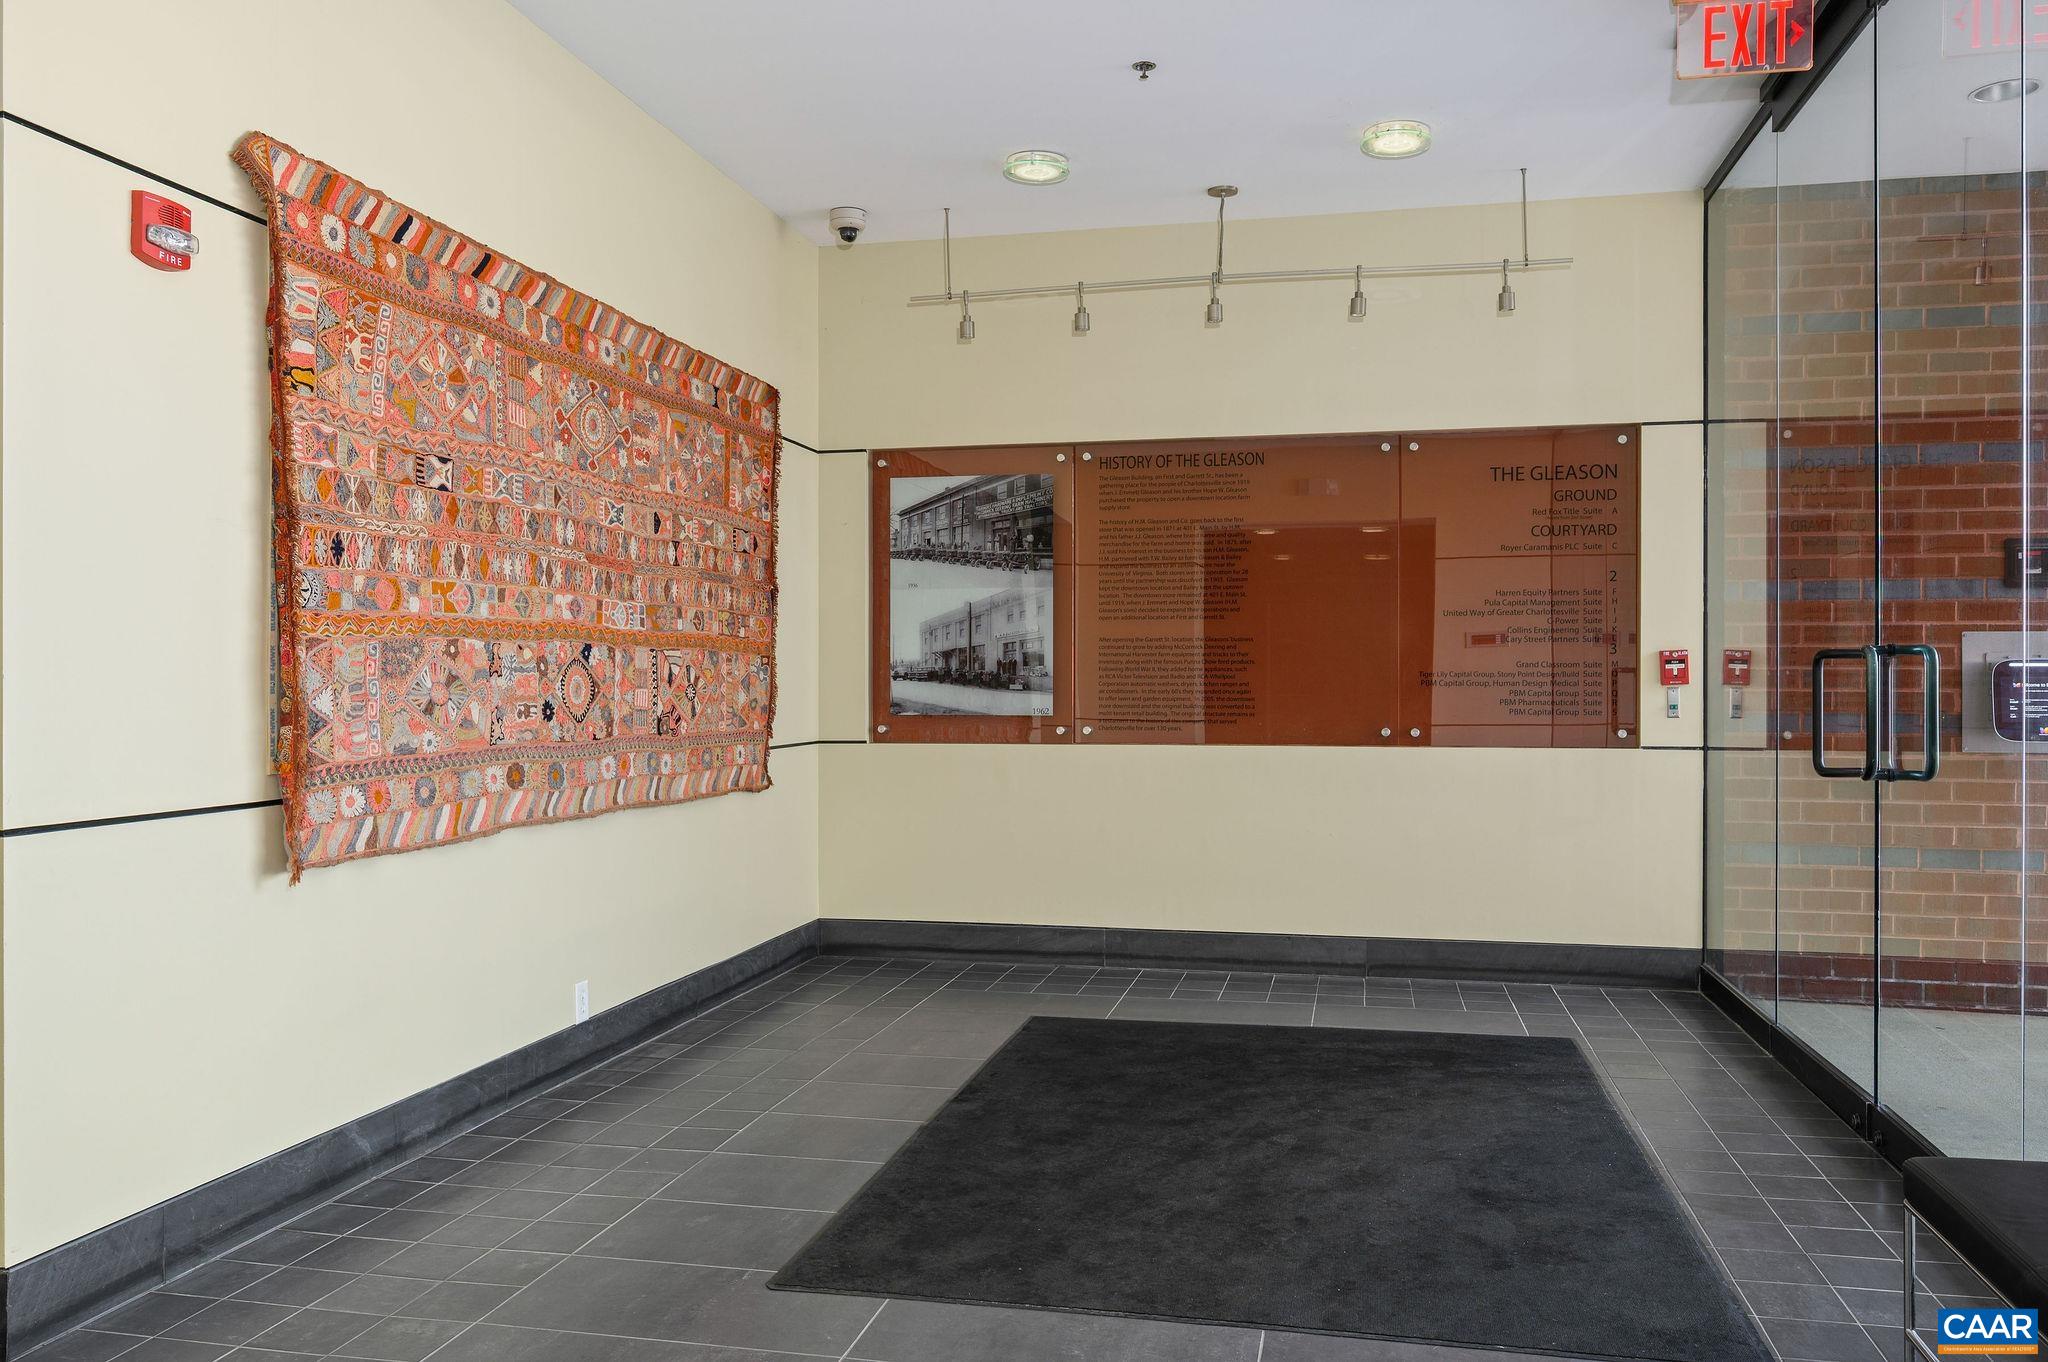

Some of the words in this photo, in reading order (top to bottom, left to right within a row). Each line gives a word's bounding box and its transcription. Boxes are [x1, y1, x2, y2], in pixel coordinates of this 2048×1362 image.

[1704, 1, 1793, 68] EXIT
[159, 251, 182, 266] FIRE
[1100, 456, 1151, 469] HISTORY
[1156, 454, 1173, 468] OF
[1176, 453, 1200, 467] THE
[1204, 452, 1264, 466] GLEASON
[1490, 466, 1525, 482] THE
[1531, 464, 1617, 481] GLEASON
[1554, 489, 1617, 501] GROUND
[1531, 524, 1617, 536] COURTYARD
[1501, 544, 1522, 553] Royer
[1609, 570, 1617, 582] 2
[1523, 589, 1546, 598] Equity
[1502, 598, 1527, 607] Capital
[1530, 599, 1580, 607] Management
[1470, 609, 1485, 618] Way
[1534, 626, 1580, 635] Engineering
[1505, 635, 1522, 644] Cary
[1609, 643, 1617, 654] 3
[1436, 671, 1448, 679] Lily
[1449, 671, 1471, 679] Capital
[1473, 671, 1496, 679] Group,
[1497, 671, 1516, 679] Stony
[1537, 670, 1580, 679] Design/Build
[1439, 680, 1464, 688] Capital
[1466, 680, 1491, 688] Group,
[1522, 680, 1548, 688] Design
[1528, 690, 1553, 698] Capital
[1555, 690, 1580, 698] Group
[1528, 709, 1553, 717] Capital
[1555, 709, 1580, 717] Group
